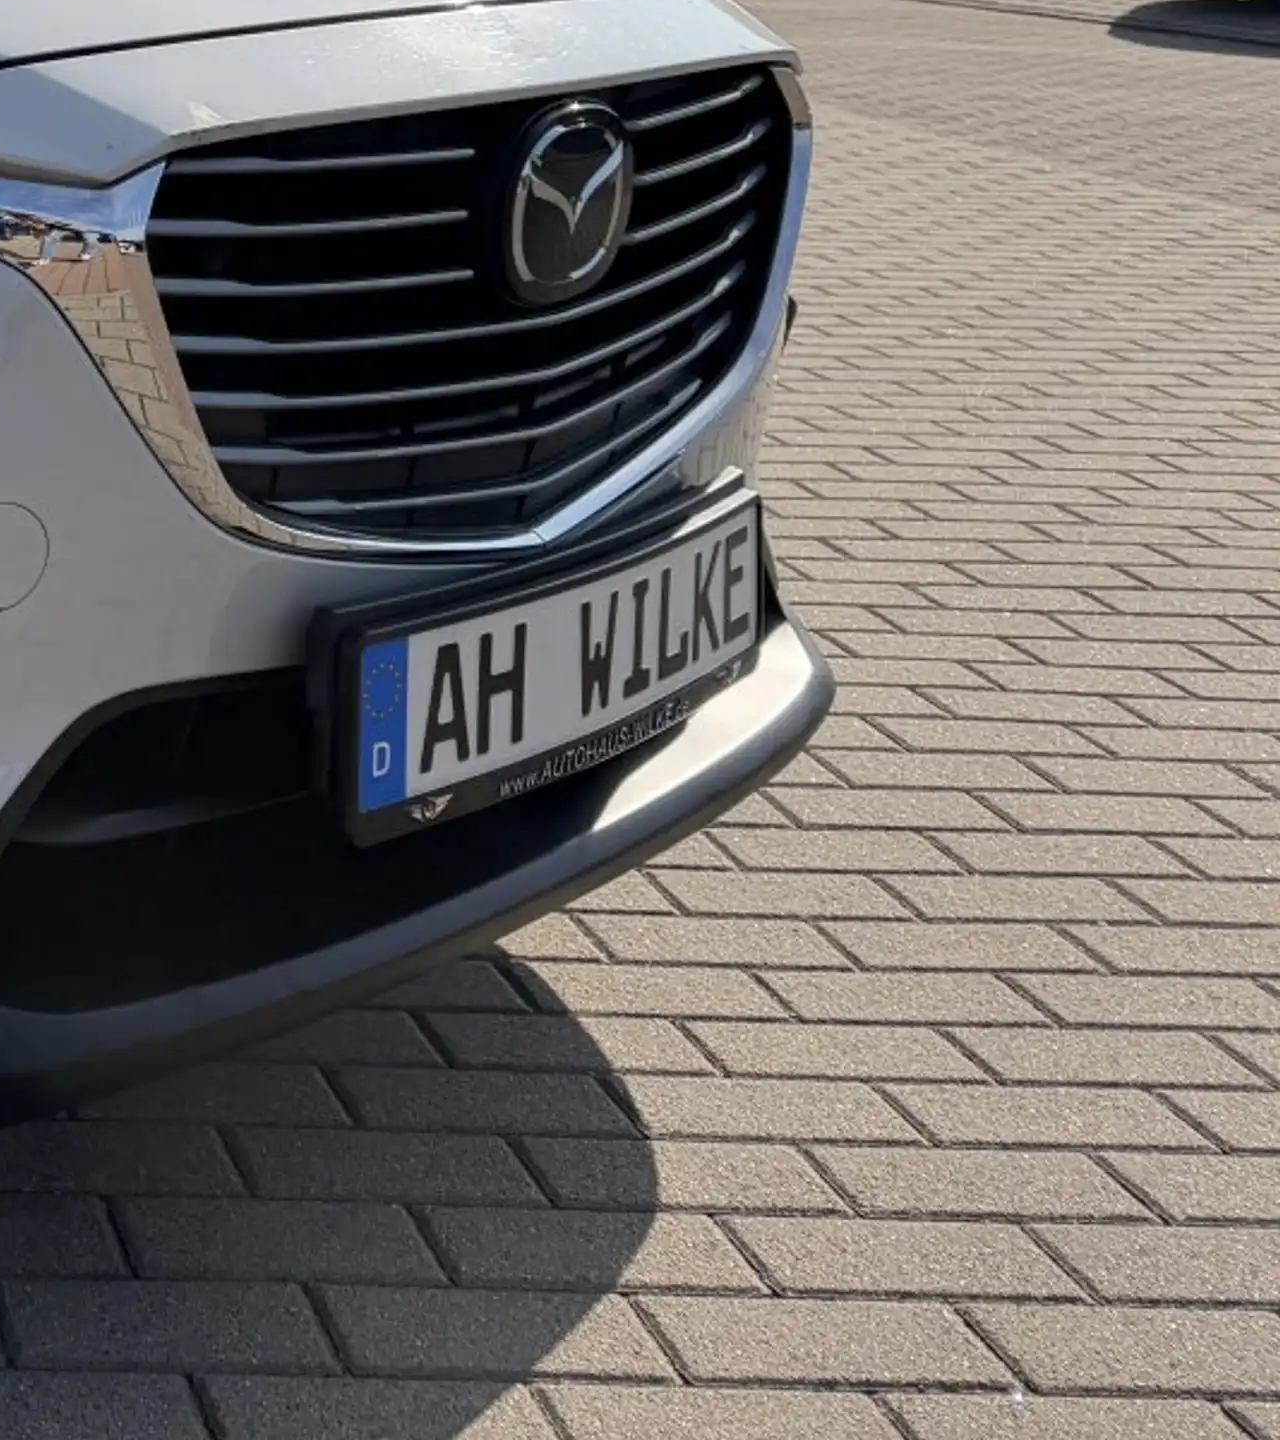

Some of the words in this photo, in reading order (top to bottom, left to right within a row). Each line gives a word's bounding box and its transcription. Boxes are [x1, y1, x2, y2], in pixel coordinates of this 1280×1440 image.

[419, 622, 527, 774] AH
[580, 526, 751, 717] WILKE
[372, 741, 391, 778] D
